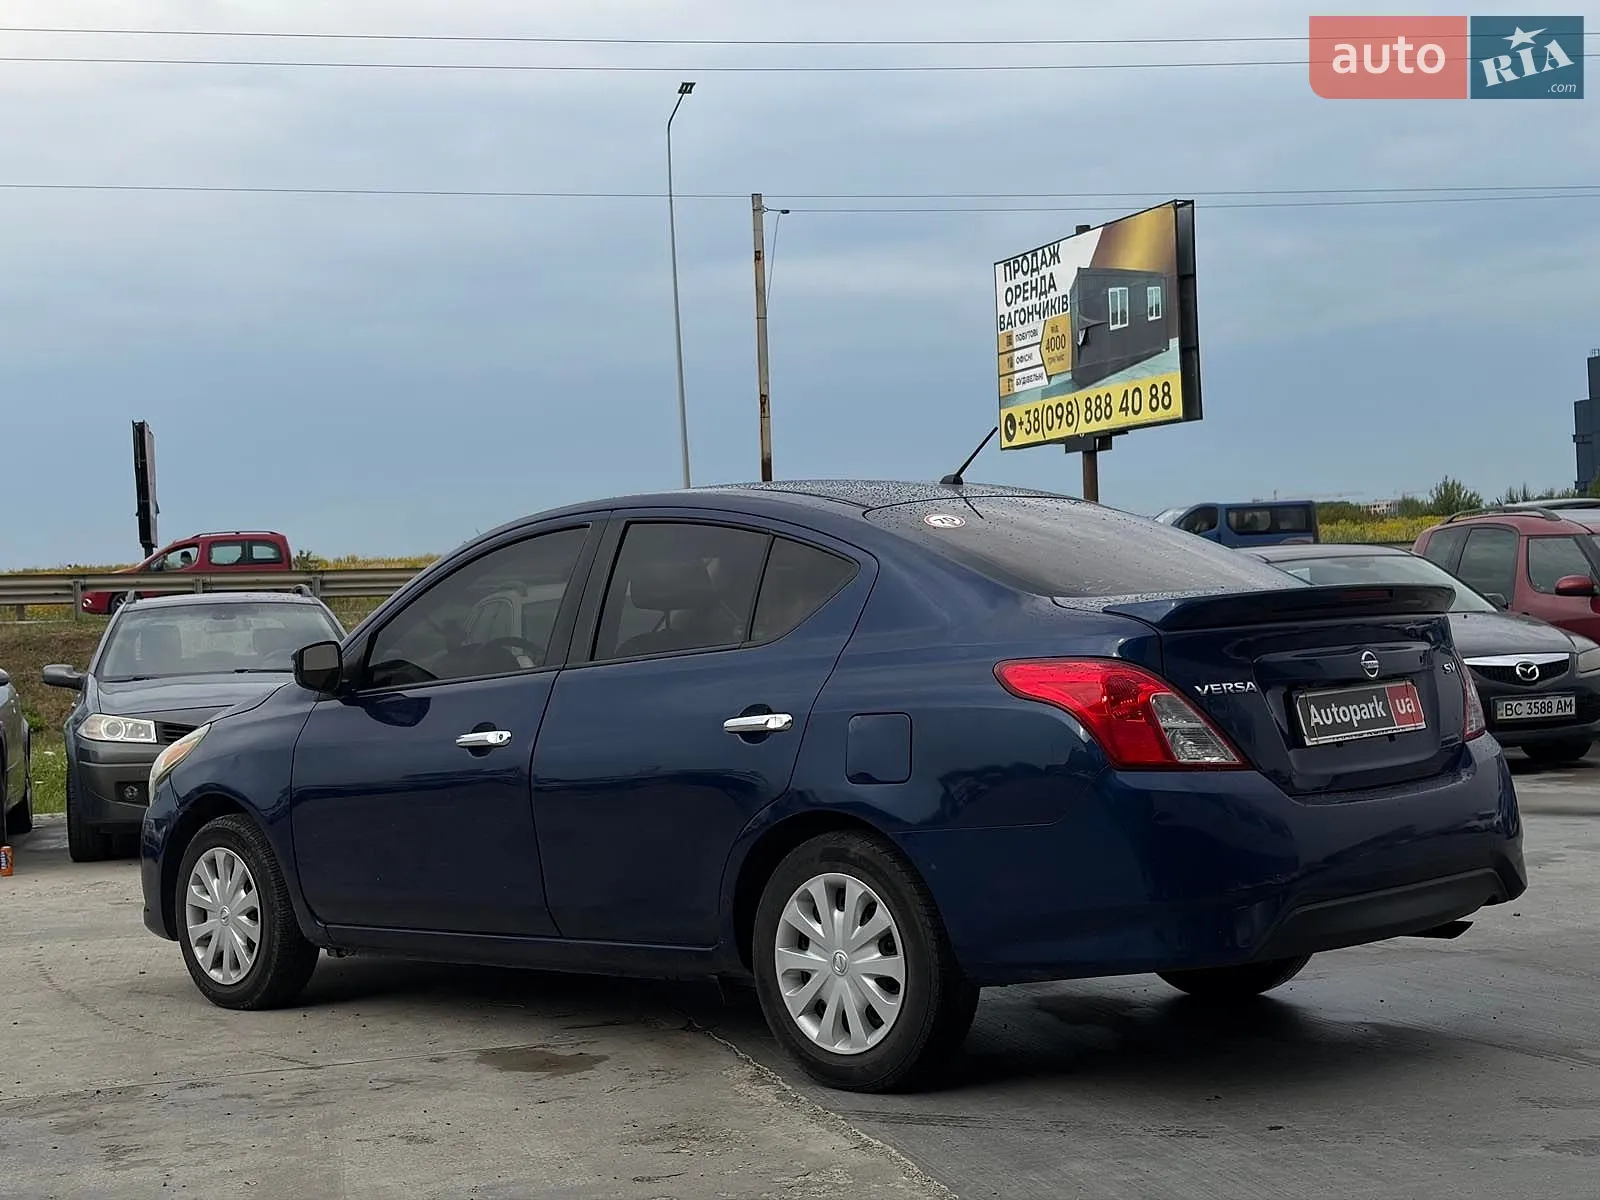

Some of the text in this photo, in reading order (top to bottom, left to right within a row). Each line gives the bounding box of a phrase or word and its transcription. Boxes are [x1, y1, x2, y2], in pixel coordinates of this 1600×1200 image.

[1003, 243, 1061, 283] ПРОДАЖ
[1004, 272, 1057, 307] ОРЕНДА
[999, 293, 1069, 332] ВАГОНЧИКІВ
[1045, 333, 1066, 353] 4000
[1018, 381, 1172, 439] +38(098) 888 40 88
[1194, 681, 1257, 697] VERSA
[1309, 695, 1416, 728] Autopark ua
[1504, 698, 1573, 717] BC 3588 AM
